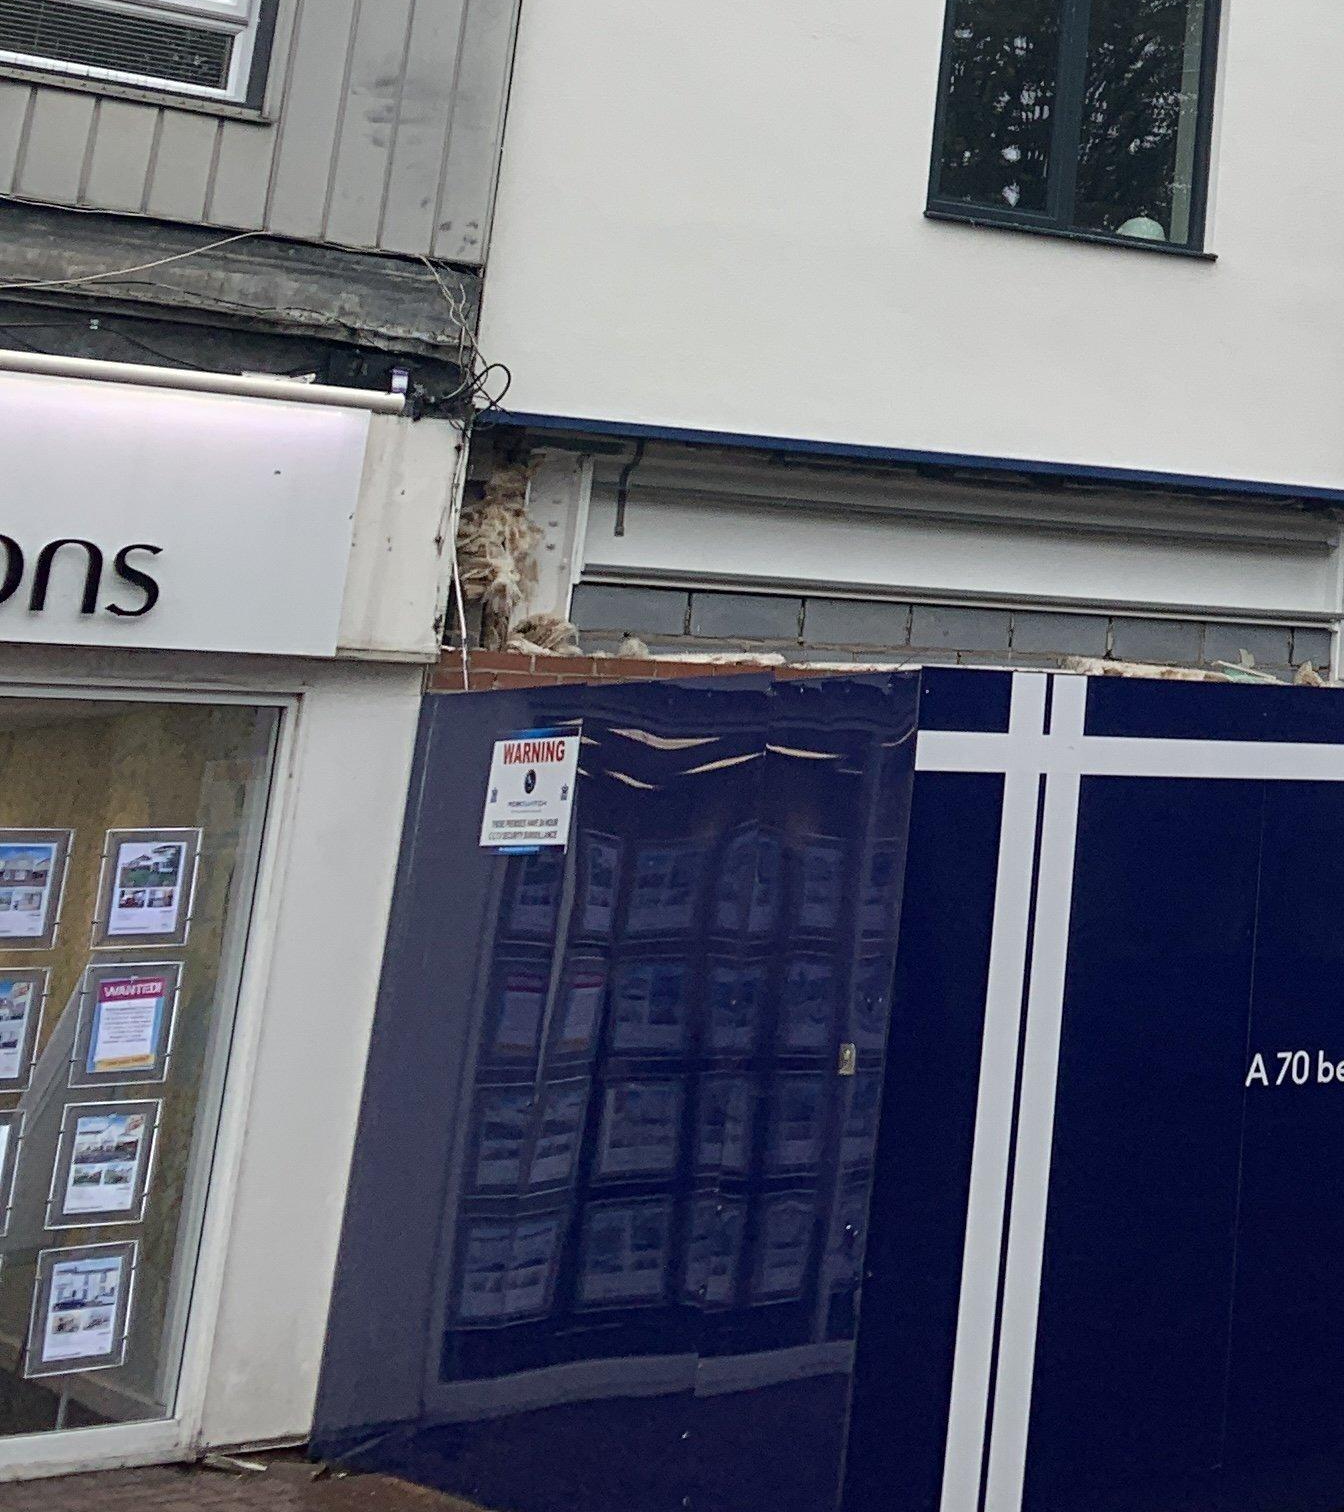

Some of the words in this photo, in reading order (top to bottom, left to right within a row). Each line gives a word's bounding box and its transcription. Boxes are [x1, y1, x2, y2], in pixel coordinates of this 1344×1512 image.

[503, 740, 565, 765] WARNING
[1245, 1052, 1269, 1087] A
[1275, 1049, 1310, 1085] 70
